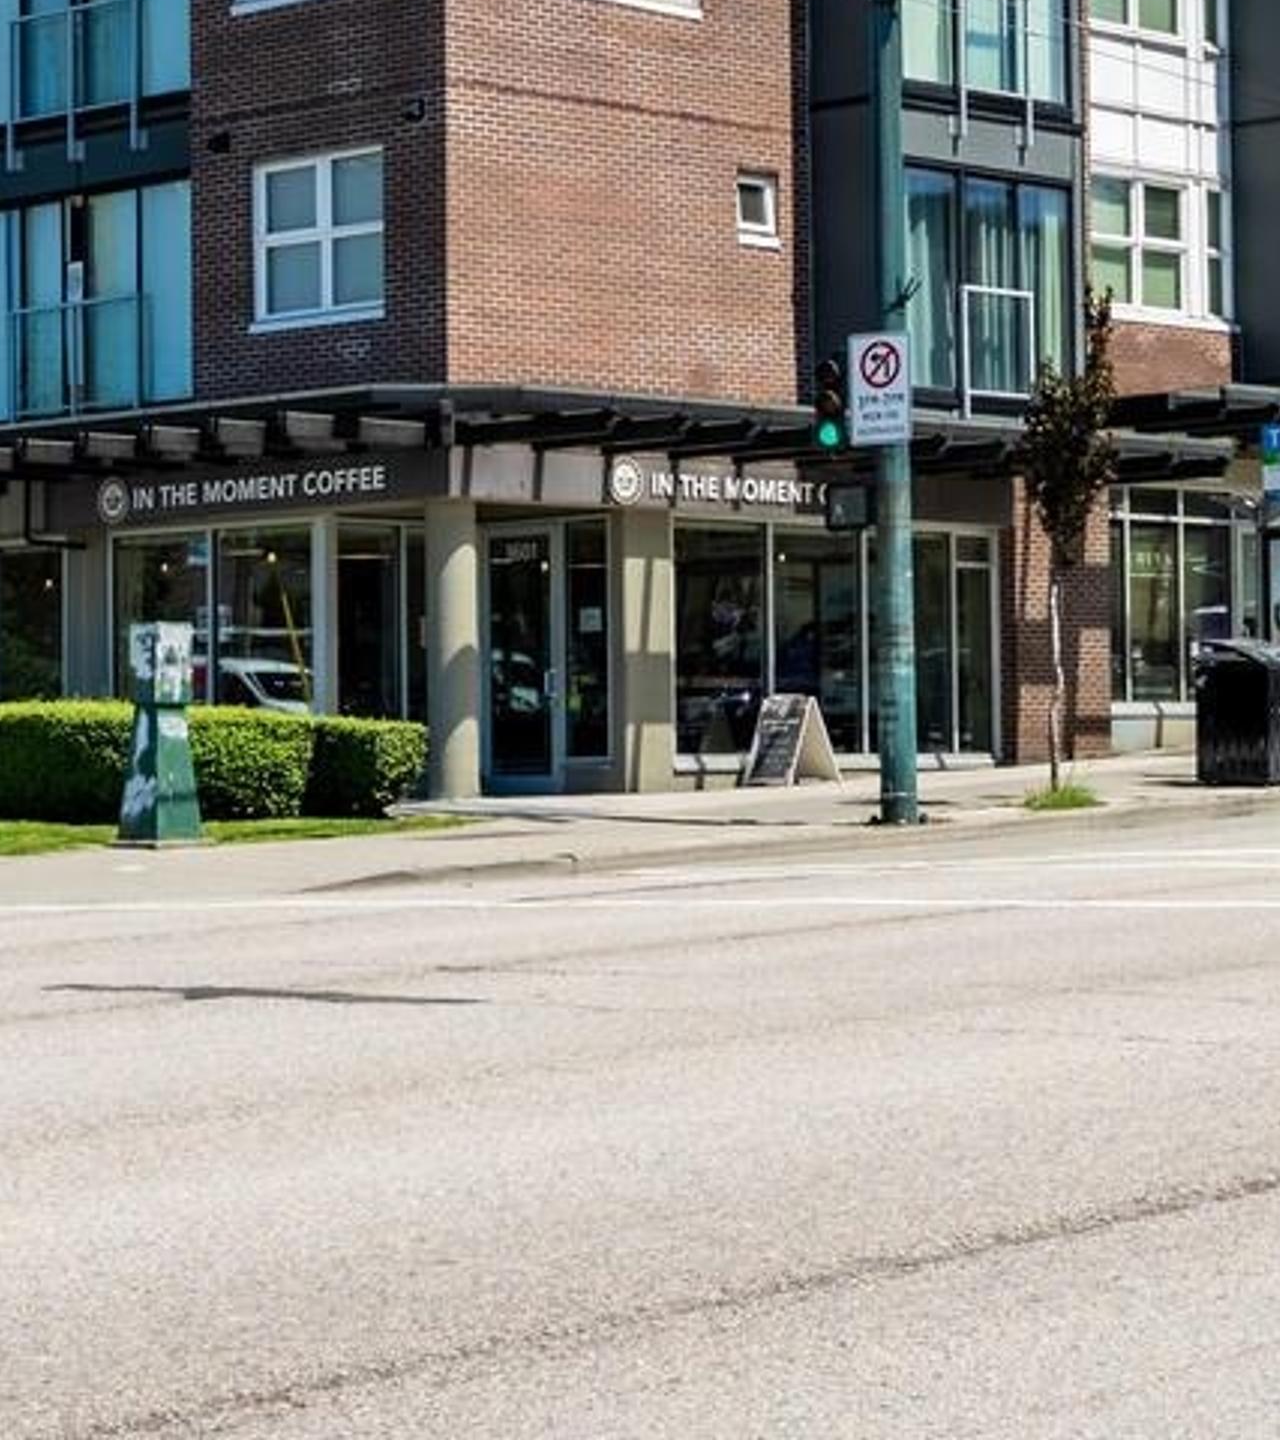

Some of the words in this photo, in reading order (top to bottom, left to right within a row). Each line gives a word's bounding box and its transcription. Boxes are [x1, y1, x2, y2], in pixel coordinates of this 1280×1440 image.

[131, 487, 155, 510] IN
[159, 481, 198, 506] THE
[202, 473, 299, 503] MOMENT
[302, 465, 387, 496] COFFEE
[651, 471, 674, 497] IN
[678, 473, 720, 500] THE
[723, 476, 814, 504] MOMENT
